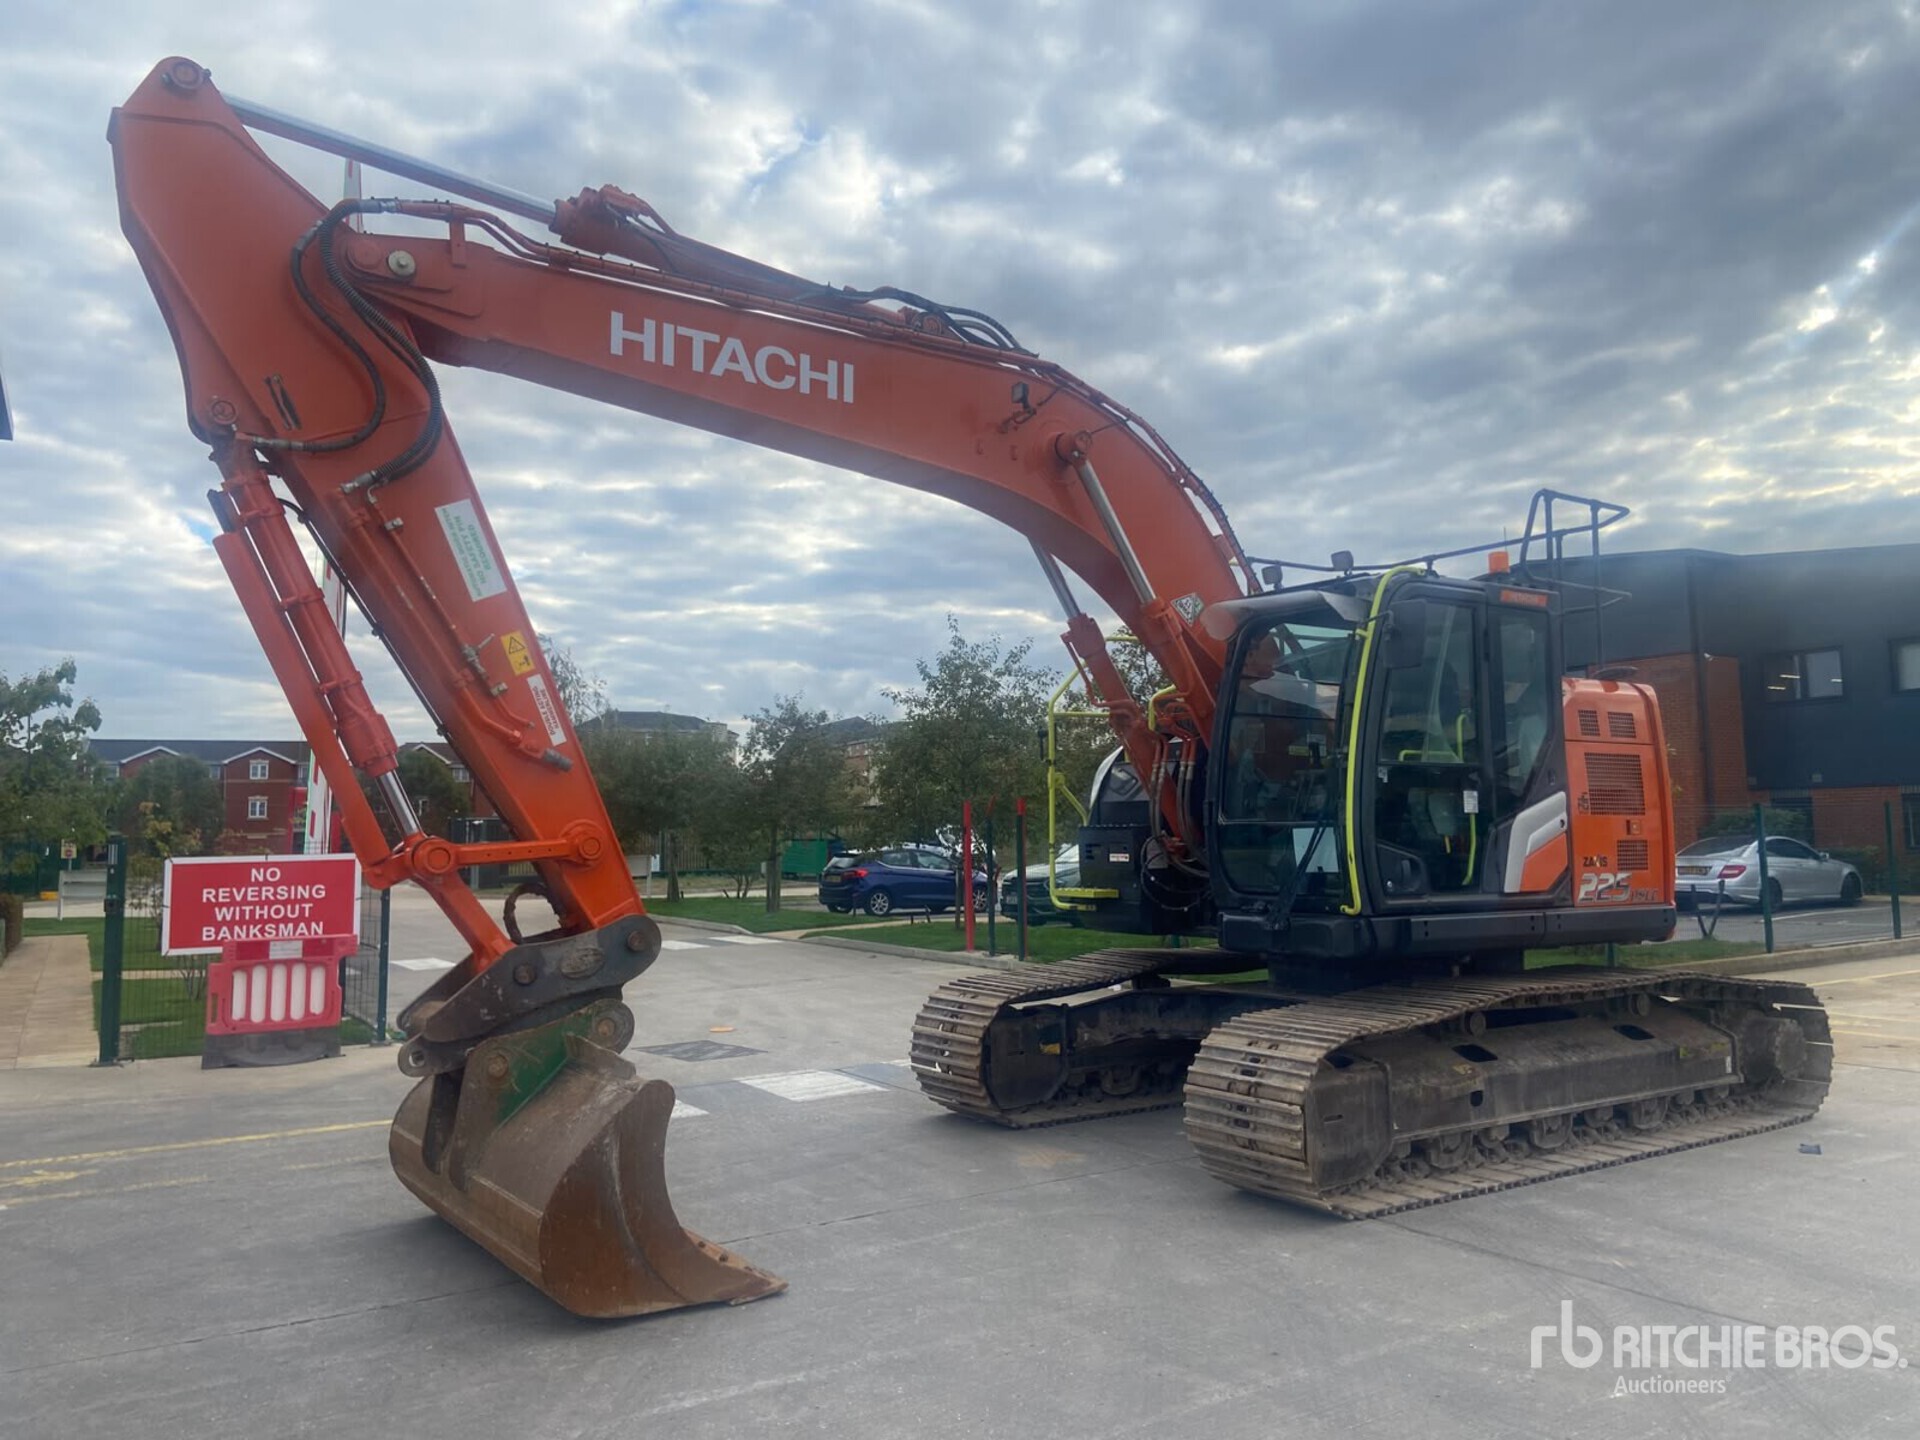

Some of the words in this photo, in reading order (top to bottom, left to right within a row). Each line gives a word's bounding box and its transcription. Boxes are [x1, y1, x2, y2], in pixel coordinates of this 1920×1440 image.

[610, 310, 854, 404] HITACHI
[460, 533, 481, 569] SAFETY
[251, 867, 281, 882] NO
[202, 884, 326, 903] REVERSING
[1578, 872, 1632, 903] 225
[214, 903, 313, 922] WITHOUT
[202, 921, 324, 941] BANKSMAN
